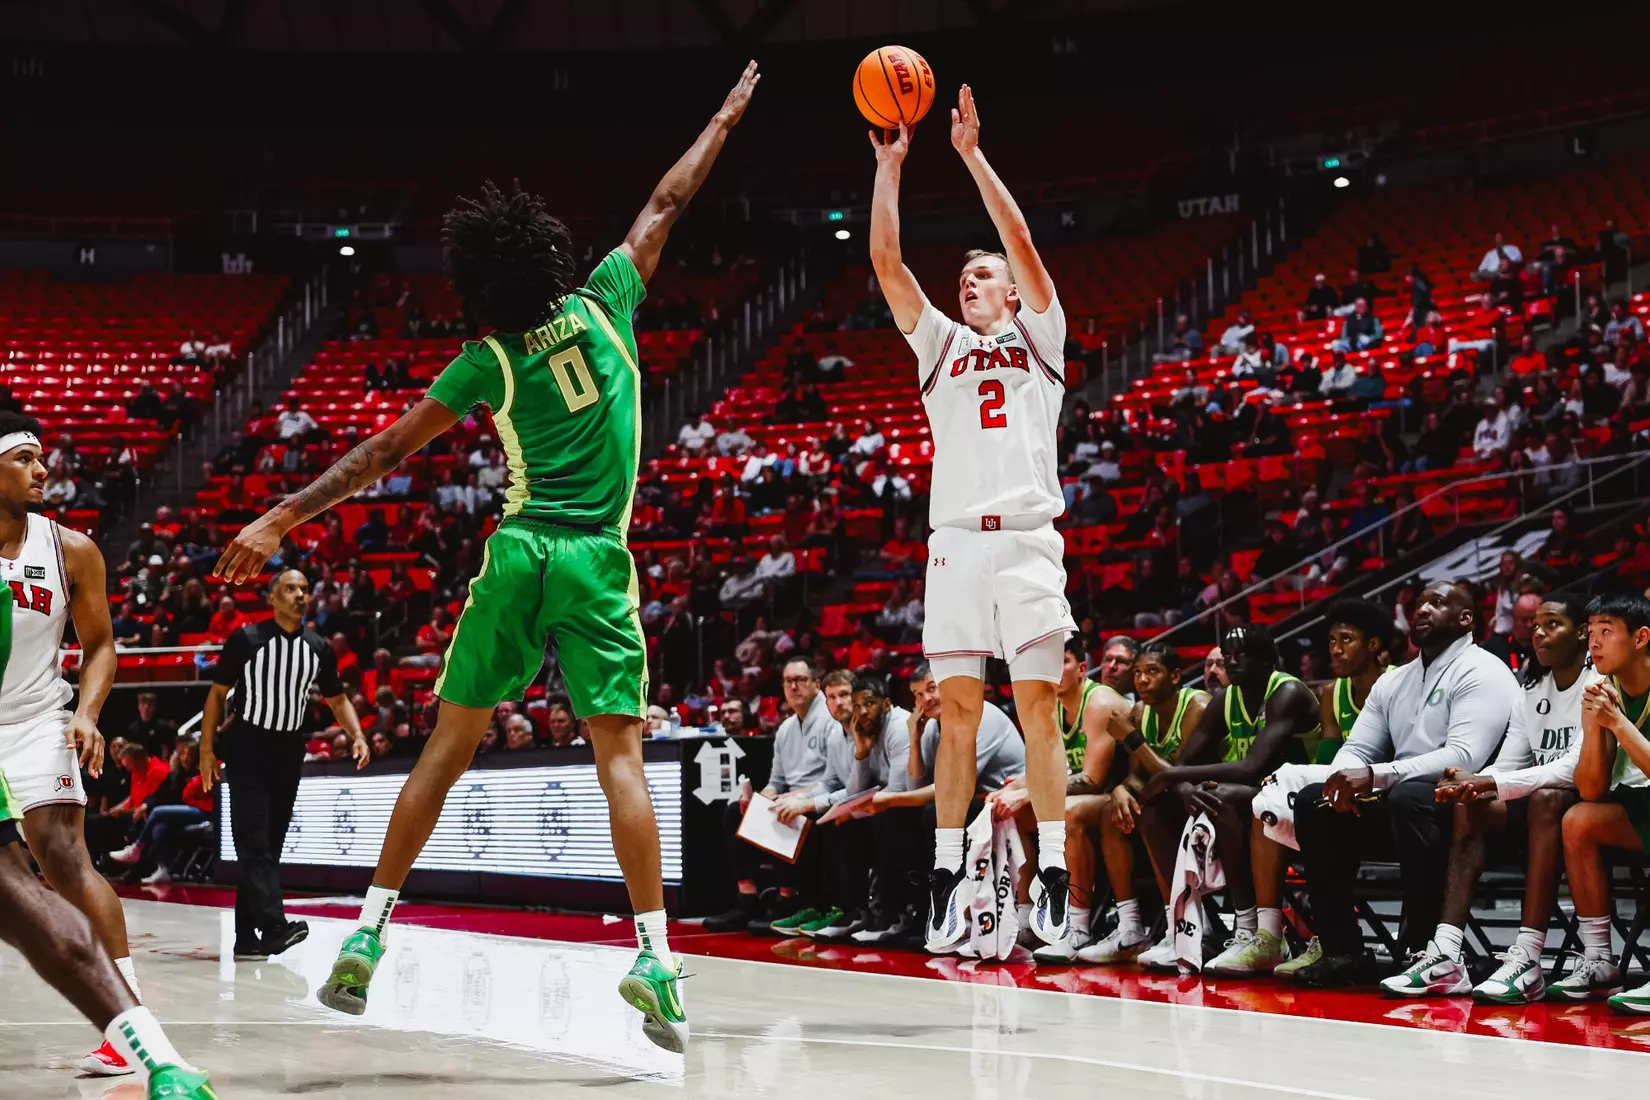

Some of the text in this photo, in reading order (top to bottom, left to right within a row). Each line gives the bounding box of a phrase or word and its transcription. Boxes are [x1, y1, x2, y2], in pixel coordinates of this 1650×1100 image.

[1178, 193, 1240, 219] UTAH
[80, 247, 95, 265] H
[523, 313, 588, 356] ARIZA
[950, 346, 1030, 378] UTAH
[978, 379, 1007, 429] 2
[5, 580, 53, 617] AH
